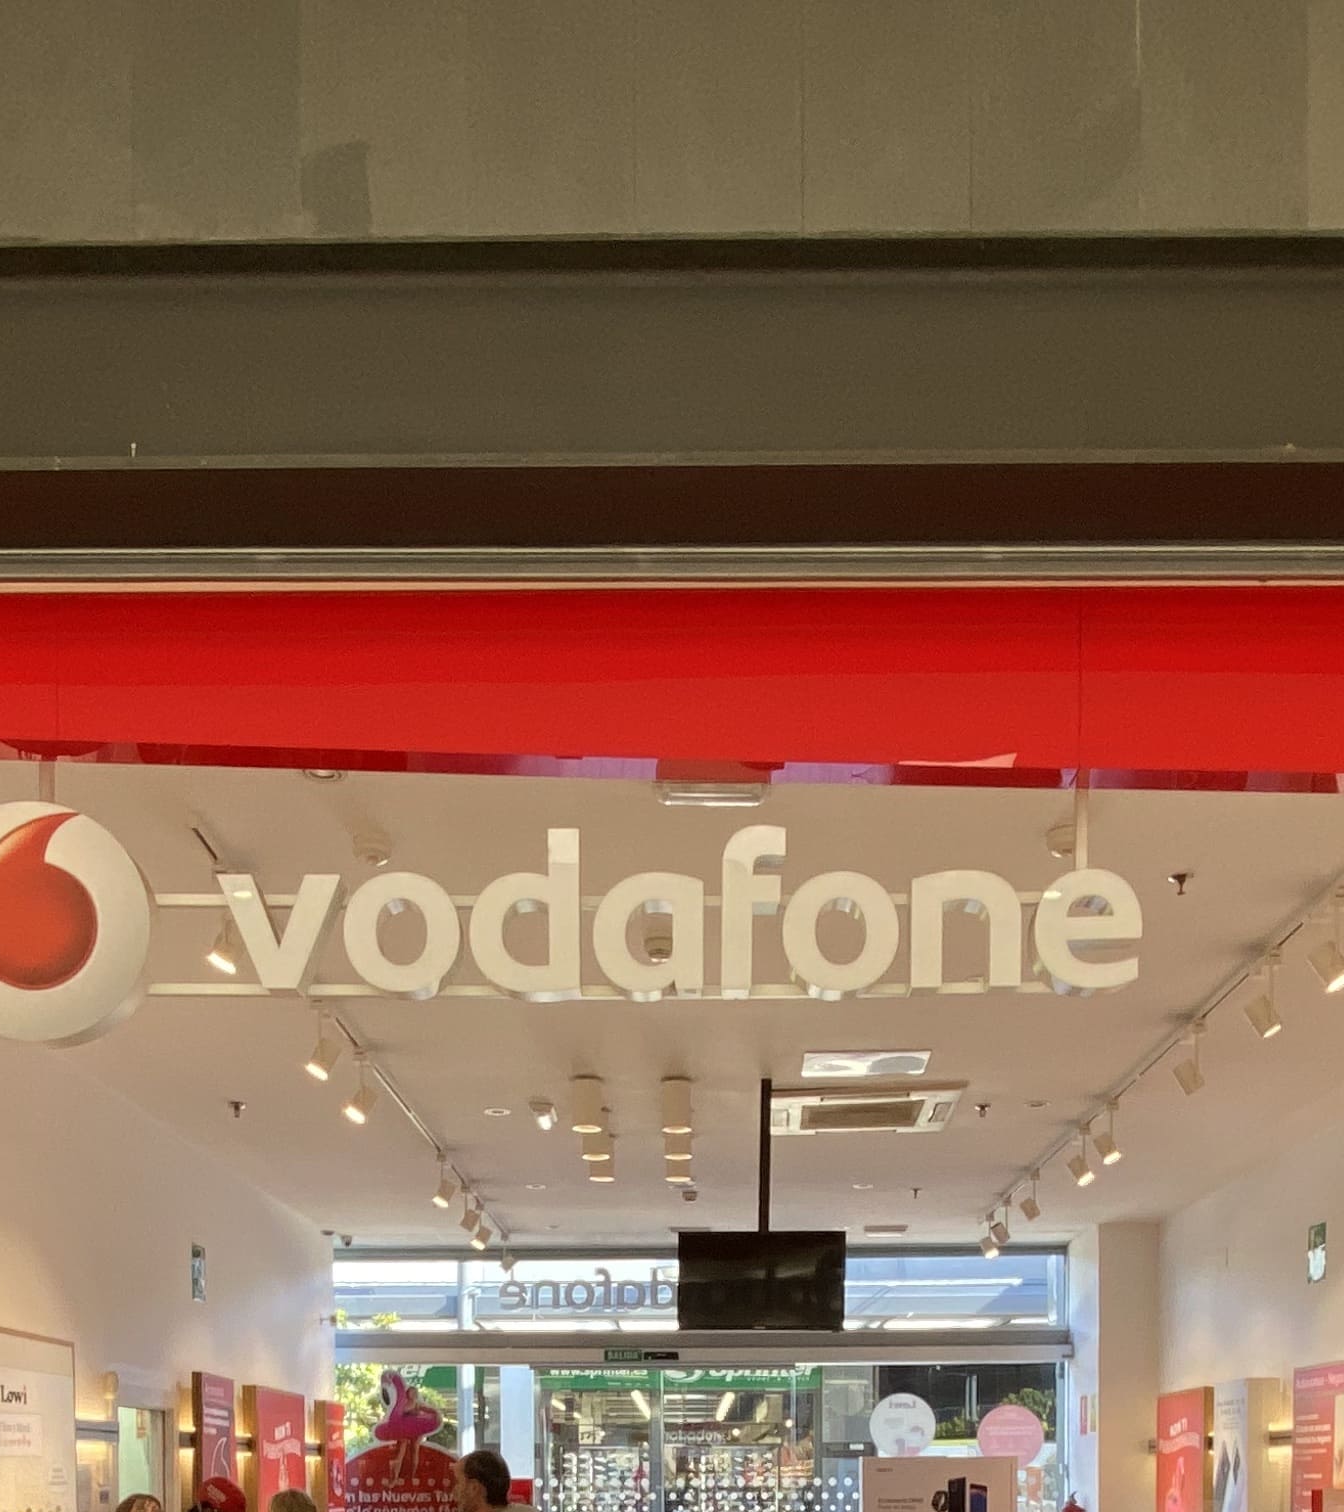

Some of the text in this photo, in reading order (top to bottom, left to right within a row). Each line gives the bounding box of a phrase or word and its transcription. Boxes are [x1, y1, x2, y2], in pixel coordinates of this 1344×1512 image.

[216, 824, 1144, 995] vodafone
[0, 1385, 28, 1405] Lowi
[383, 1490, 431, 1502] Nuevas
